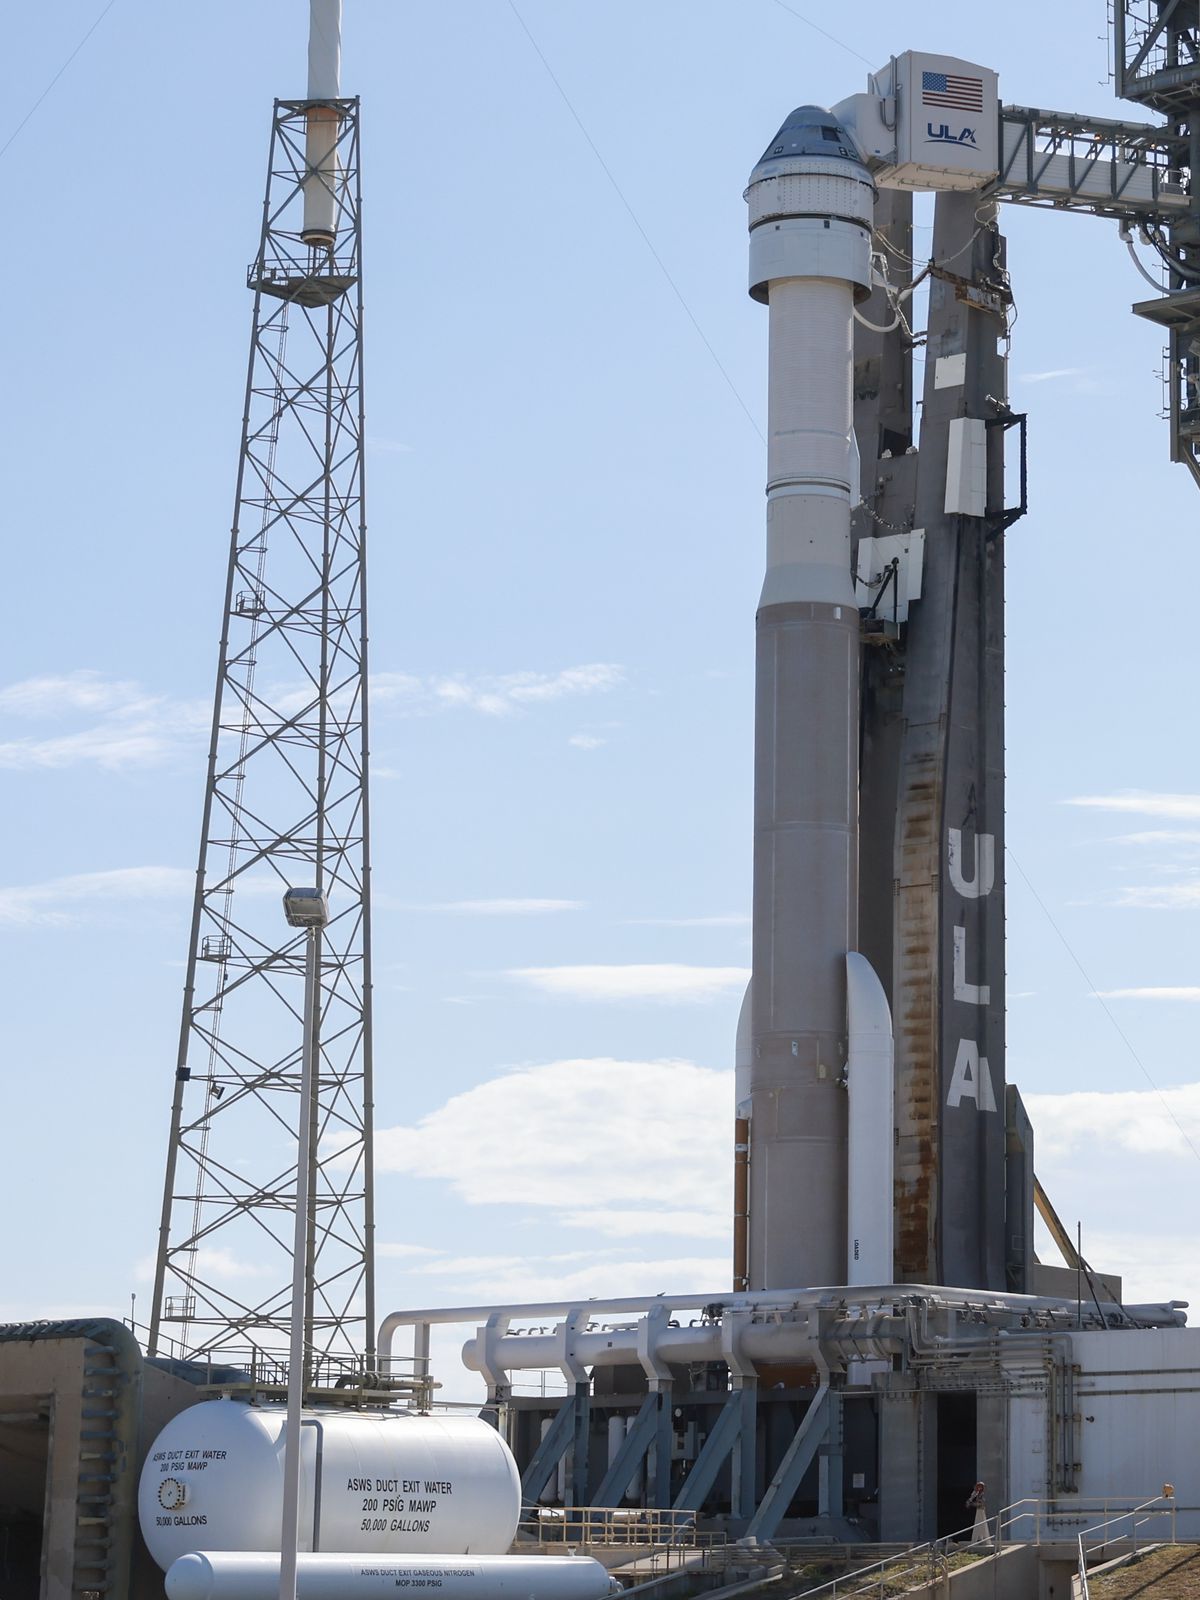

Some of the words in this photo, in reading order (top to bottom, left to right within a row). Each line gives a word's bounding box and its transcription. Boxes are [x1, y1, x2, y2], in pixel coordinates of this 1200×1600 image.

[927, 123, 977, 144] ULA
[946, 827, 998, 1112] ULA
[167, 1451, 184, 1461] DUCT
[185, 1450, 200, 1459] EXIT
[202, 1450, 227, 1460] WATER
[160, 1463, 170, 1472] 200
[171, 1462, 185, 1471] PSIG
[187, 1462, 208, 1471] MAWP
[347, 1478, 372, 1492] ASWS
[376, 1479, 399, 1493] DUCT
[402, 1480, 421, 1493] EXIT
[424, 1480, 453, 1495] WATER
[362, 1498, 378, 1511] 200
[382, 1498, 405, 1512] PSIG
[408, 1499, 437, 1513] MAWP
[174, 1515, 208, 1526] GALLONS
[360, 1518, 387, 1532] 50,000
[390, 1519, 431, 1532] GALLONS
[413, 1569, 443, 1577] GASEOUS
[444, 1569, 475, 1577] NITROGEN
[395, 1579, 411, 1587] MOP
[411, 1579, 426, 1587] 3300
[427, 1579, 442, 1587] PSIG
